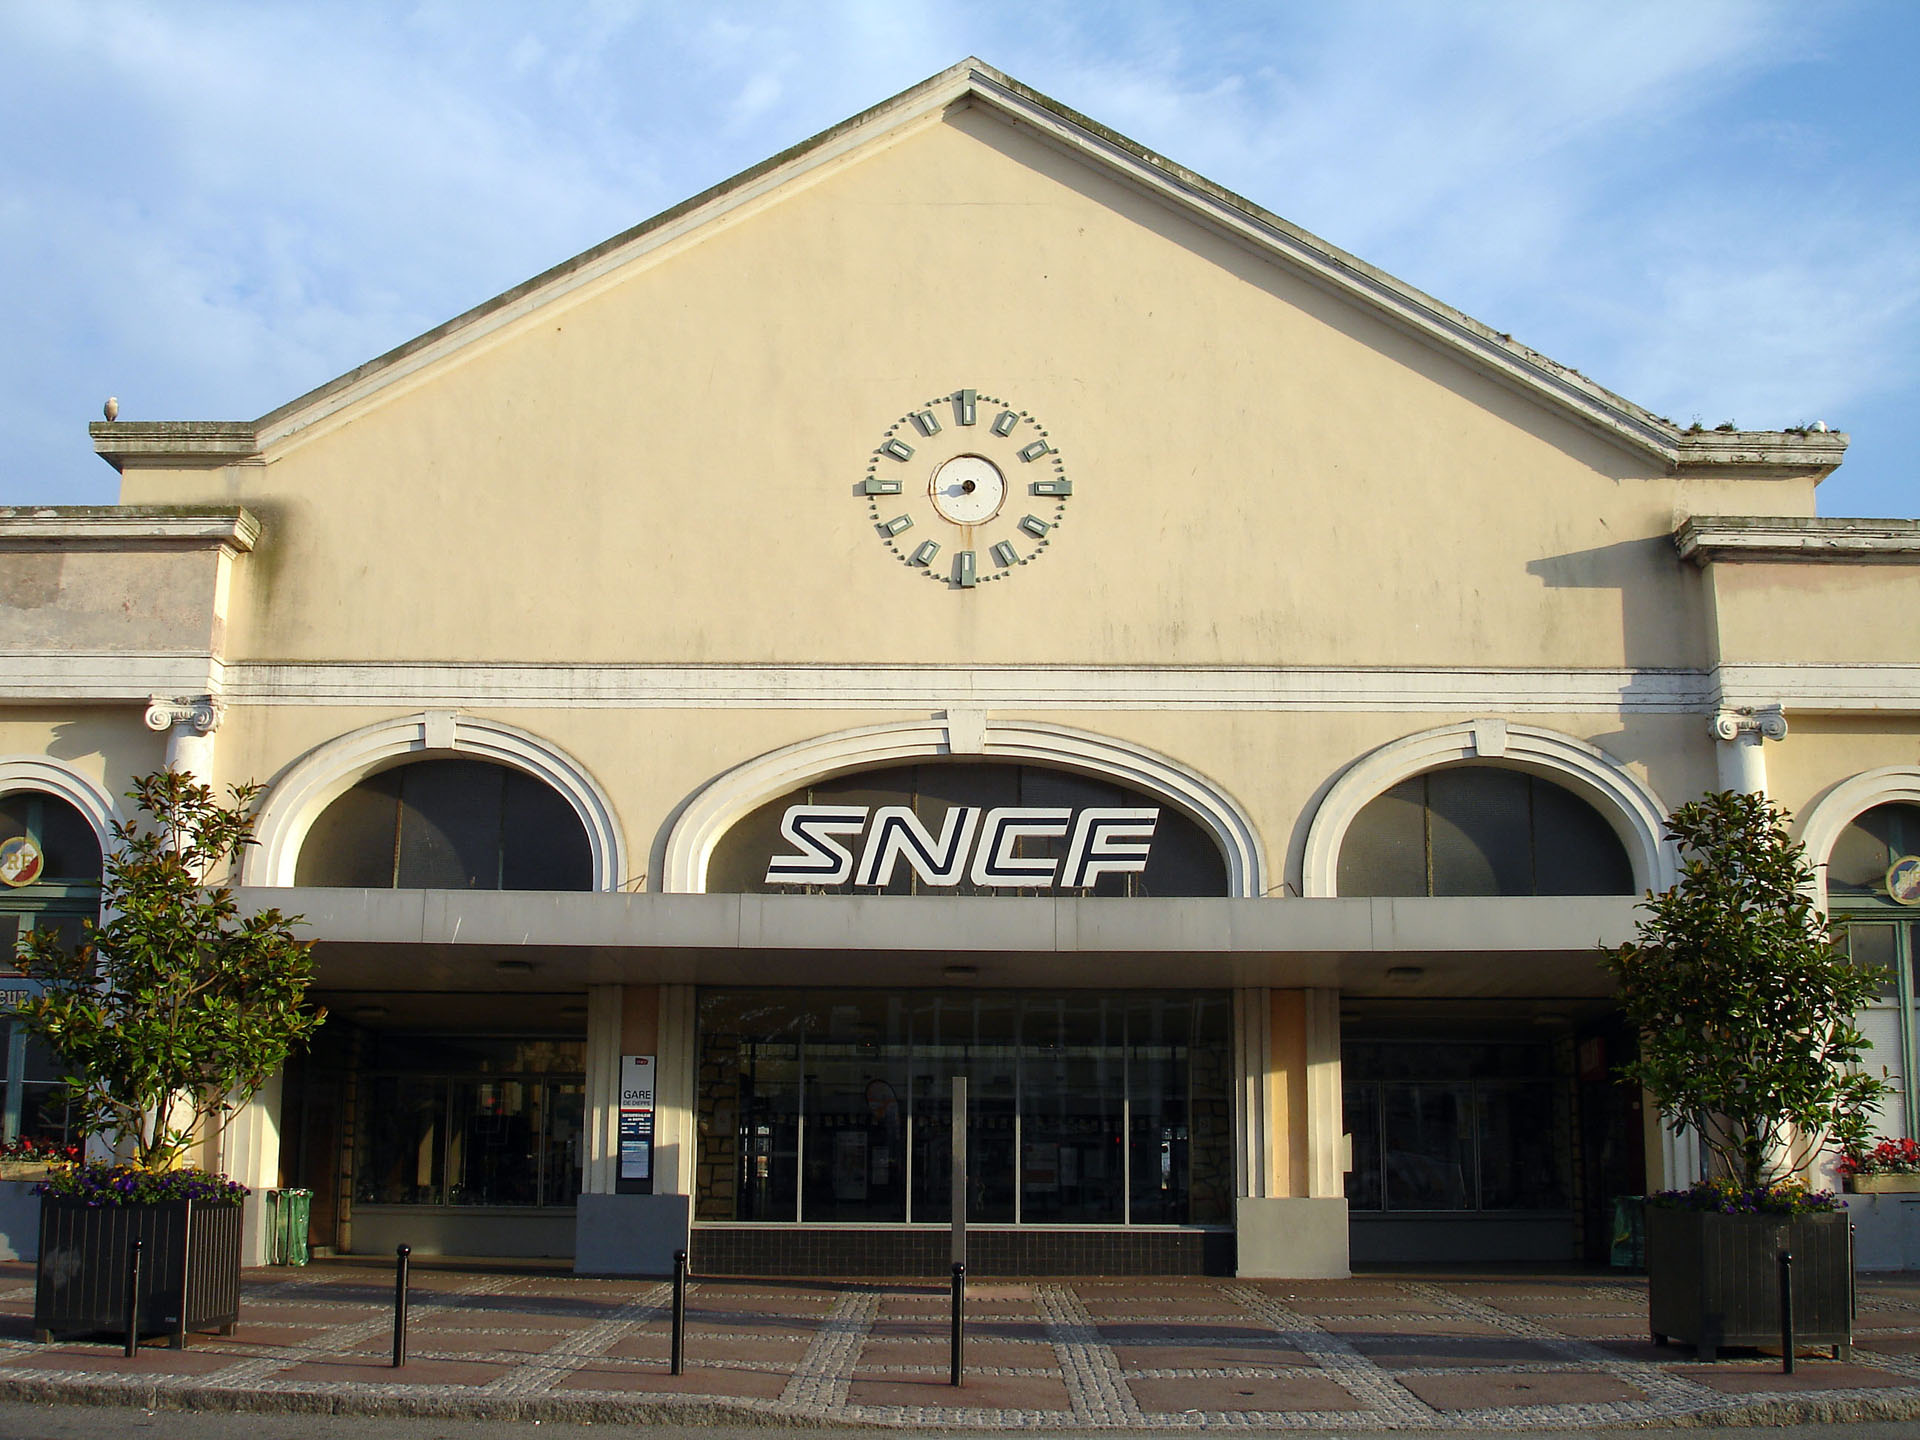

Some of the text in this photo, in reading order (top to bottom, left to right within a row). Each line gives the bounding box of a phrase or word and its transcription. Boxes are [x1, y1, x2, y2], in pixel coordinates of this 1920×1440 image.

[764, 804, 1160, 888] SNCF
[7, 853, 33, 871] RF
[623, 1090, 651, 1099] GARE
